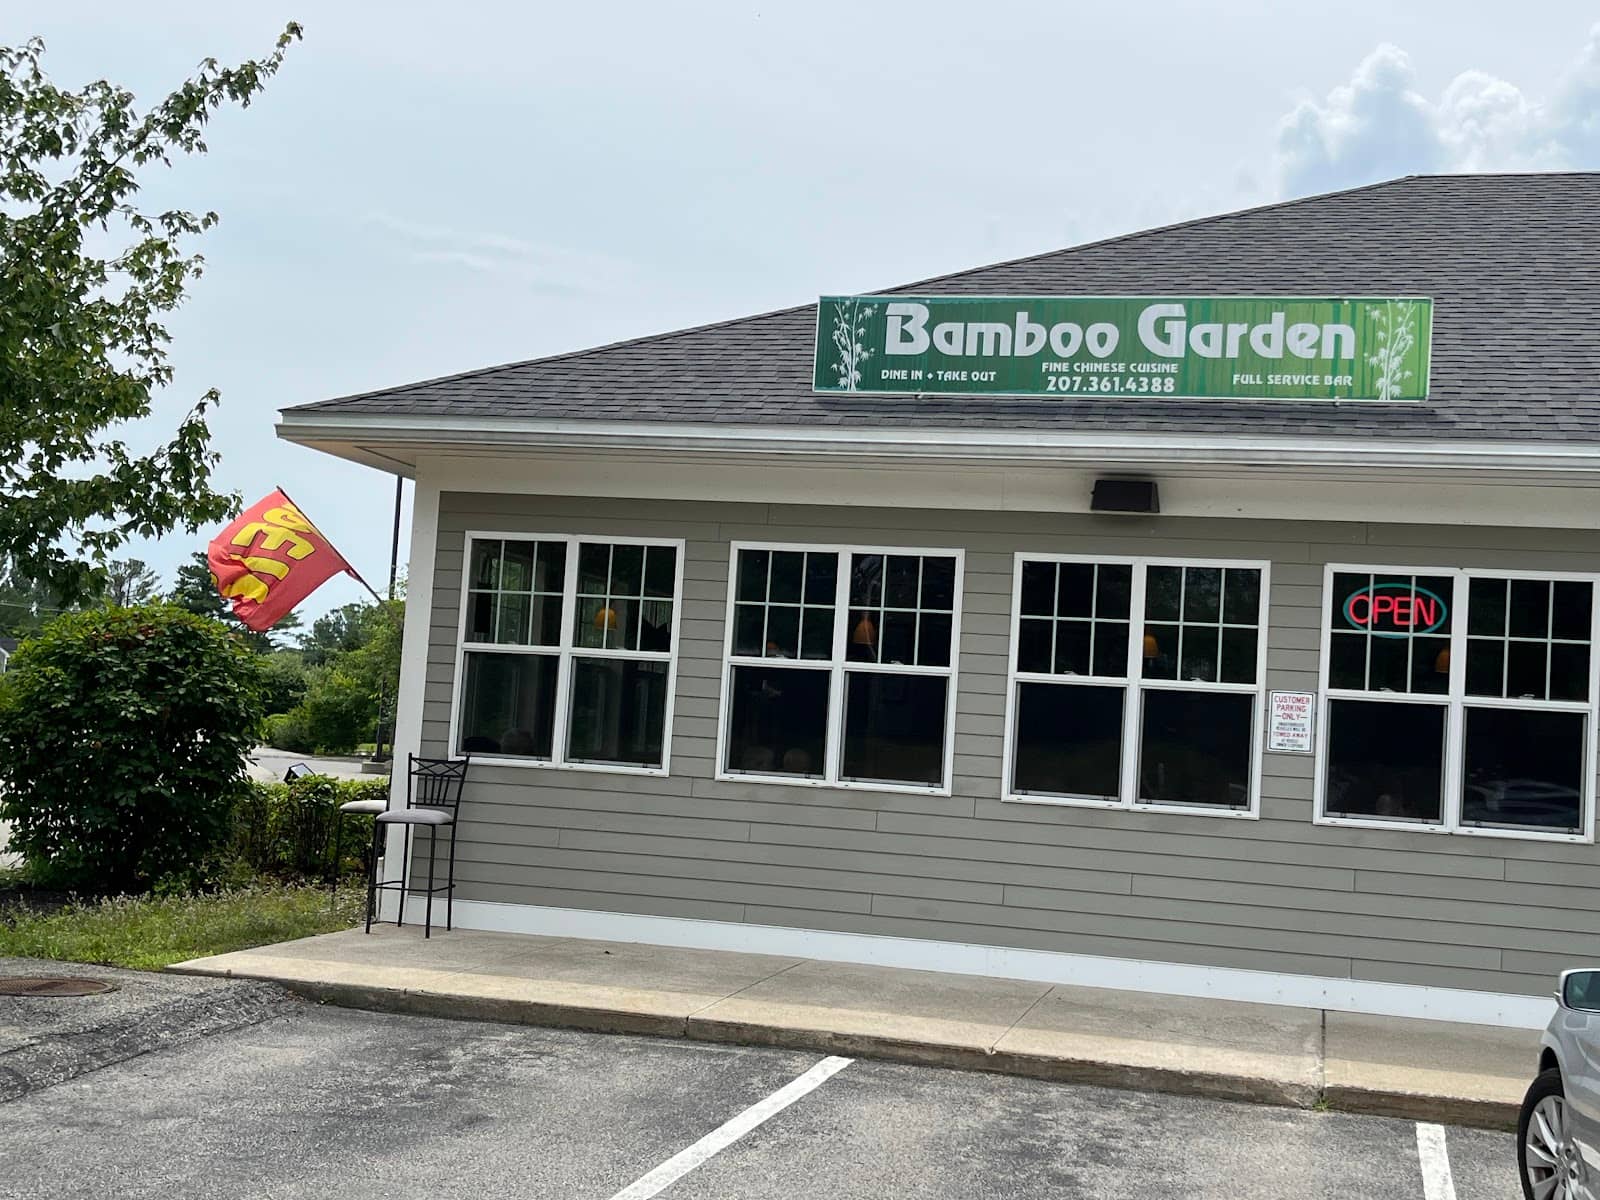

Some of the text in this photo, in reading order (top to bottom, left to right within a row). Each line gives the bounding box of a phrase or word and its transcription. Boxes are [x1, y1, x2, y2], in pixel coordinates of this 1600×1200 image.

[885, 302, 1356, 360] Bamboo Garden
[1042, 362, 1179, 373] FINE CHINESE CUISINE
[881, 369, 997, 382] DINE IN TAKE OUT
[1233, 373, 1353, 387] FULL SERVICE BAR
[1046, 375, 1175, 393] 207.361.4388
[1349, 595, 1436, 626] OPEN
[1274, 696, 1310, 705] CUSTOMER
[1277, 704, 1307, 712] PARKING
[1281, 712, 1301, 720] ONLY
